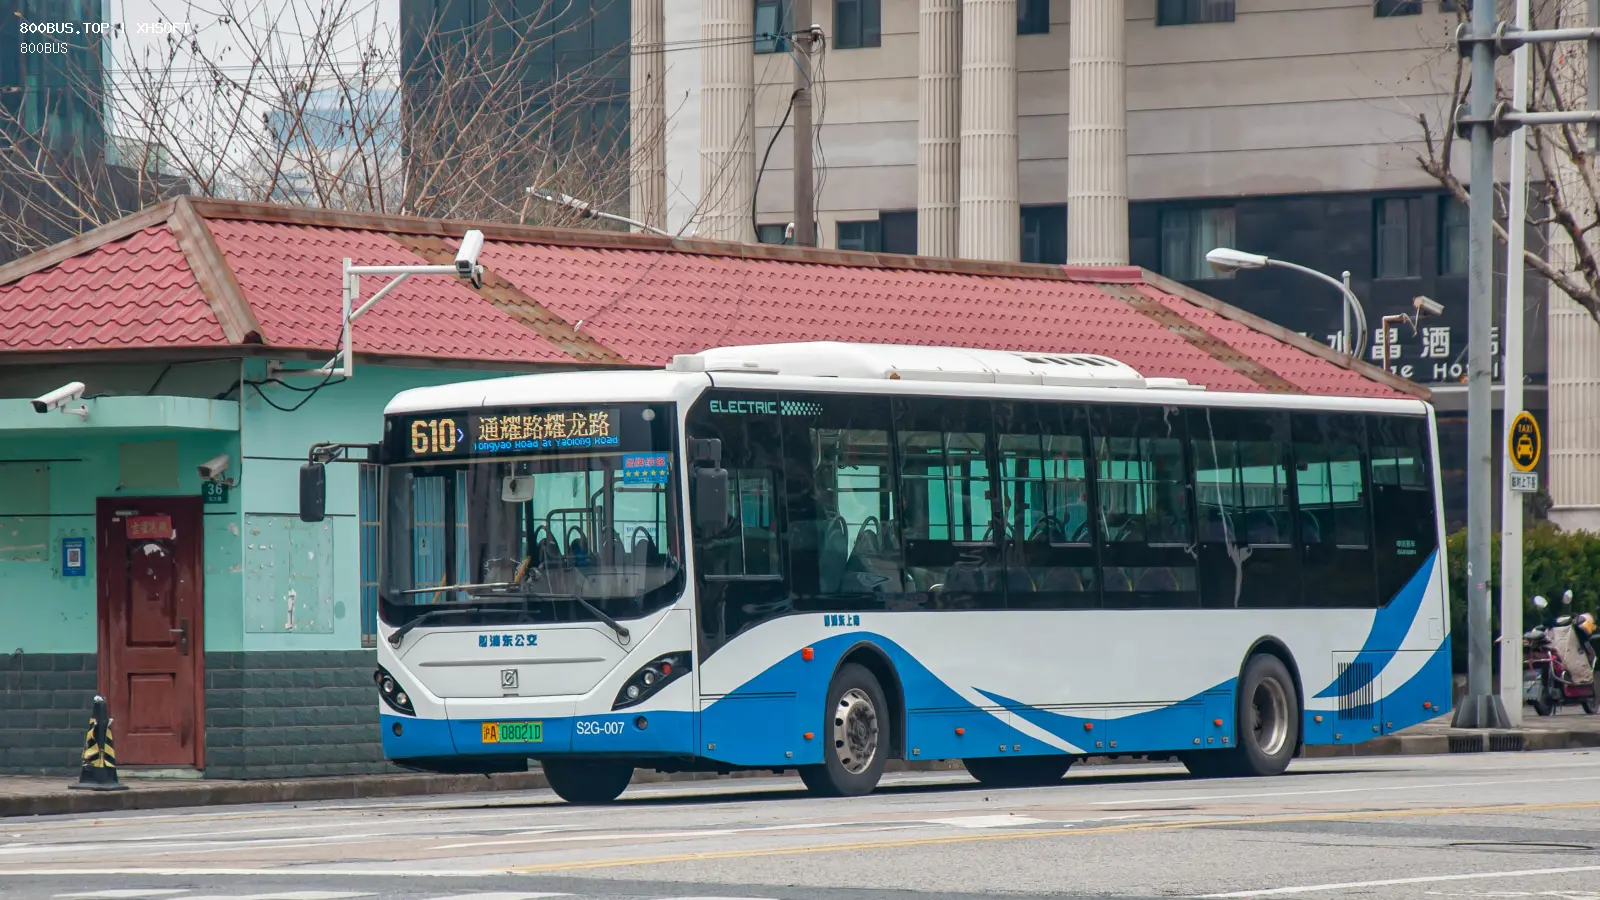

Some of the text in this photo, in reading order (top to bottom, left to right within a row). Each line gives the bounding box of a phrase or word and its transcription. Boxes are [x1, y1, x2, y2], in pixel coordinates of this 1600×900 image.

[1433, 361, 1499, 379] Hol
[709, 399, 777, 414] ELECTRIC
[478, 411, 610, 441] 通耀路耀龙路
[1518, 423, 1533, 433] TAXI
[411, 418, 456, 454] 610
[207, 483, 223, 495] 36
[489, 633, 538, 647] 浦东公交
[576, 721, 625, 735] S2G-007
